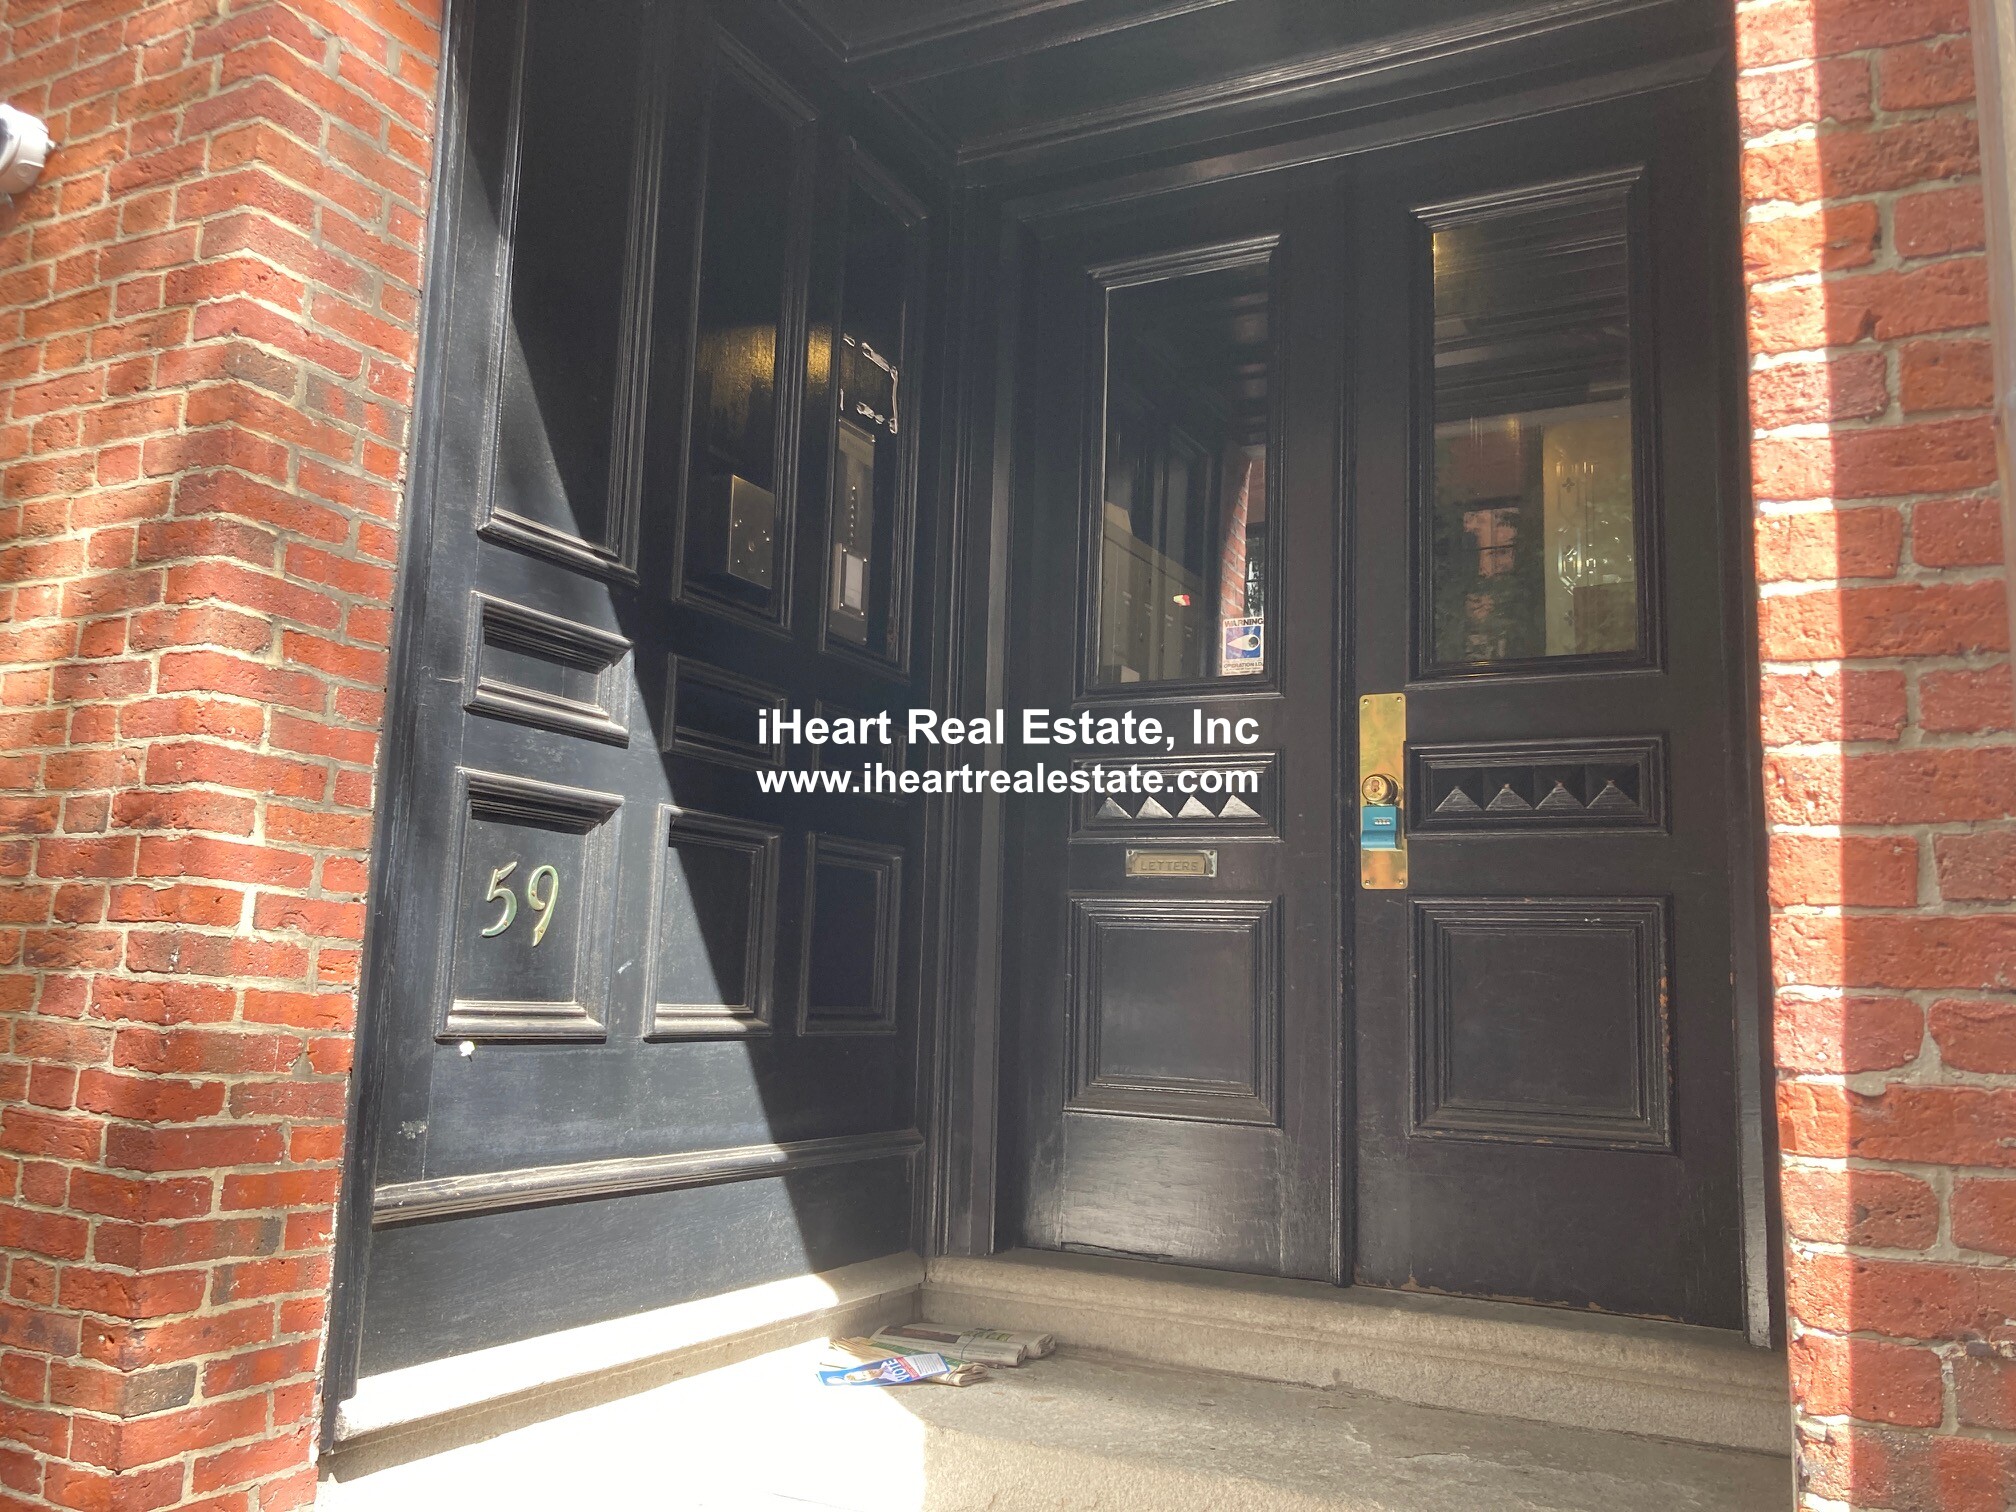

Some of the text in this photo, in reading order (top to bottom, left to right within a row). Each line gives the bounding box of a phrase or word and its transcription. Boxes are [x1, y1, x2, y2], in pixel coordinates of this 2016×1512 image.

[1225, 618, 1263, 627] WARNING
[1141, 862, 1198, 871] LETTERS
[481, 861, 559, 947] 59
